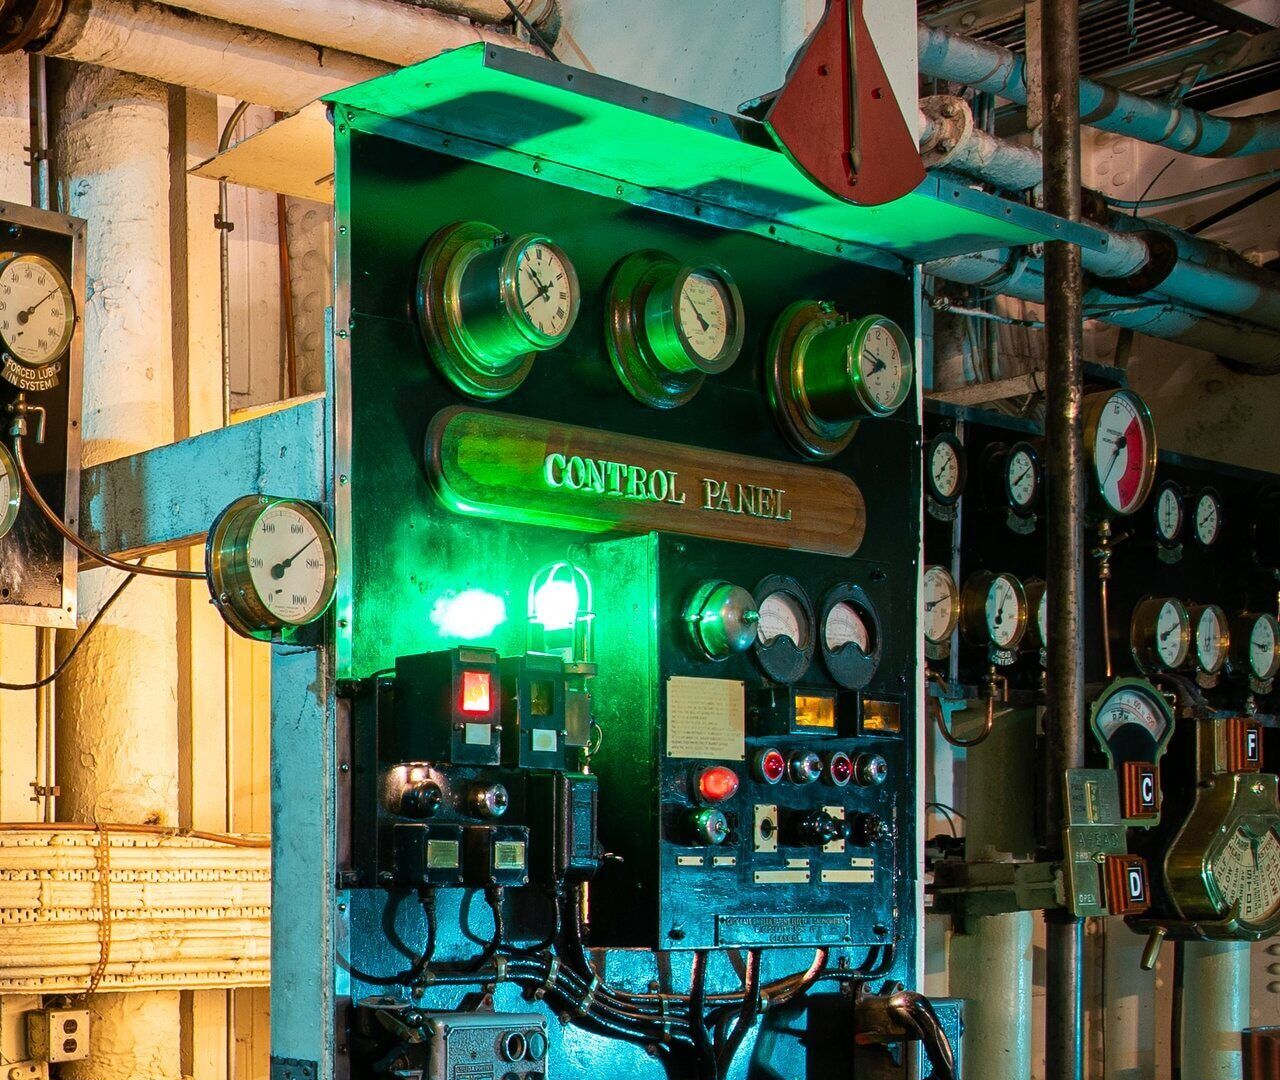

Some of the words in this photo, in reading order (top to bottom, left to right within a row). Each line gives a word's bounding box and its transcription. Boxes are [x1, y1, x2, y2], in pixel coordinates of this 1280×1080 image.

[5, 359, 36, 379] FORCED
[19, 378, 55, 391] SYSTEM)
[543, 452, 686, 505] CONTROL
[701, 477, 793, 522] PANEL
[291, 524, 304, 534] 600
[306, 560, 319, 569] 800
[292, 595, 307, 605] 1000
[1248, 731, 1256, 757] F
[1142, 776, 1152, 802] C
[1129, 871, 1141, 898] D
